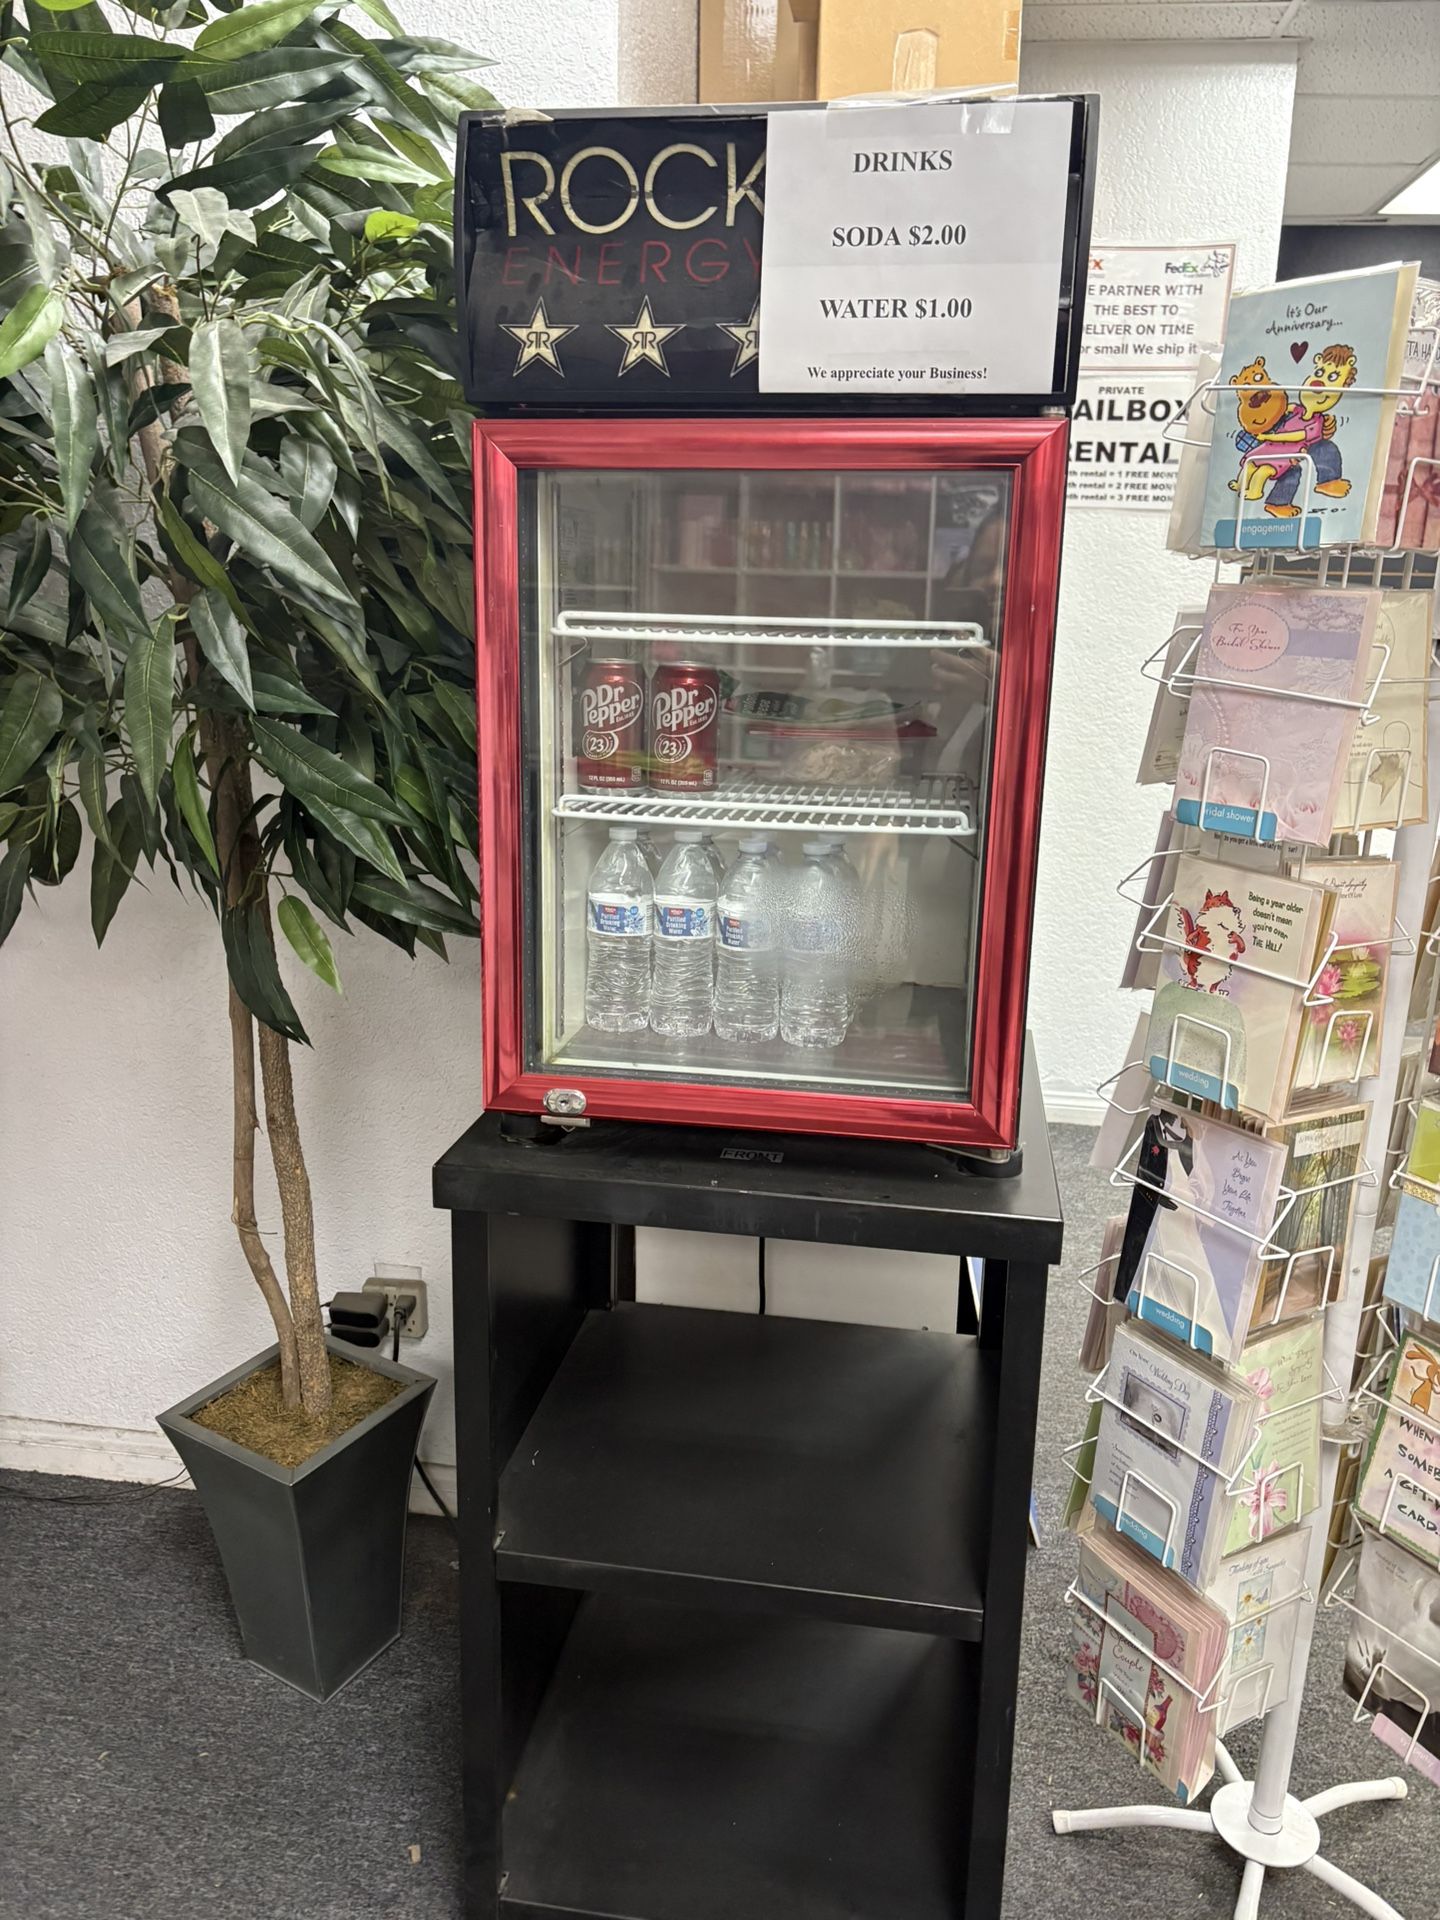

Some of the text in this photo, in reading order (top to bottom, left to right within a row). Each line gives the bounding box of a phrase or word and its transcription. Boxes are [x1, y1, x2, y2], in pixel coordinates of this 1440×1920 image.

[852, 149, 952, 173] DRINKS
[832, 224, 966, 247] SODA $2.00
[503, 238, 762, 286] ENERGY
[1165, 262, 1198, 274] FedEx
[1100, 284, 1160, 296] PARTNER
[1165, 284, 1203, 295] WITH
[820, 297, 972, 319] WATER $1.00
[1094, 304, 1179, 316] THE BEST TO
[1286, 303, 1327, 318] It's Our
[1083, 324, 1194, 335] ELIVER ON TIME
[1265, 317, 1343, 335] Anniversary...
[1094, 343, 1128, 355] small
[1132, 344, 1153, 355] We
[1156, 343, 1182, 356] ship
[1187, 343, 1198, 354] it
[807, 366, 987, 381] We appreciate your Business!
[1098, 386, 1145, 395] PRIVATE
[1073, 399, 1187, 422] AILBOX
[1069, 441, 1179, 464] ENTAL
[1241, 524, 1294, 535] engagement
[1249, 639, 1280, 650] Shower
[597, 684, 624, 708] Dr
[671, 688, 699, 711] Dr
[581, 689, 639, 728] Pepper
[653, 692, 713, 731] Pepper
[590, 737, 604, 752] 23
[662, 741, 677, 755] 23
[1205, 807, 1255, 823] ridal shower
[1248, 891, 1265, 906] Being
[1270, 900, 1285, 908] year
[1286, 902, 1303, 913] older
[1252, 908, 1292, 926] doesn't mean
[1252, 922, 1288, 940] you're over
[1178, 1070, 1210, 1089] wedding
[723, 1149, 779, 1162] FRONT
[1155, 1308, 1185, 1330] wedding
[1399, 1416, 1435, 1445] WHEN
[1398, 1443, 1440, 1481] SOMEB
[1113, 1644, 1145, 1672] Couple
